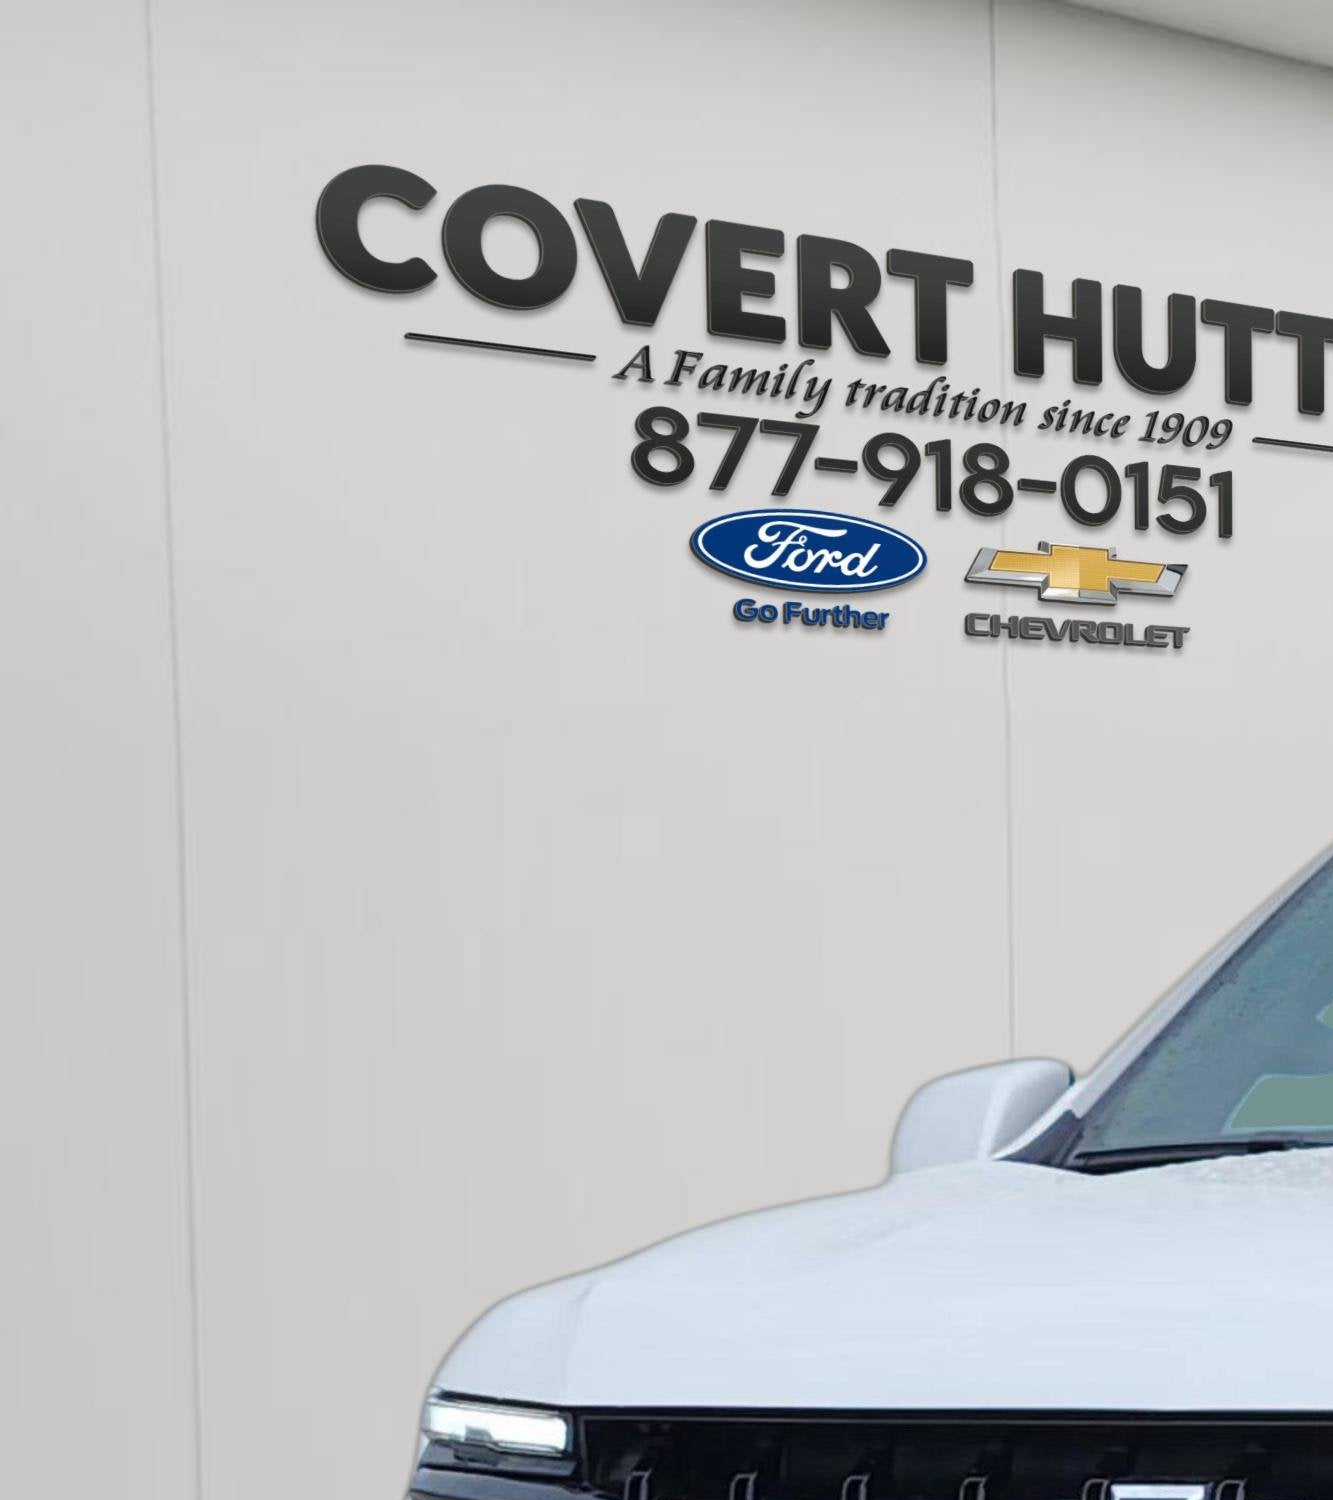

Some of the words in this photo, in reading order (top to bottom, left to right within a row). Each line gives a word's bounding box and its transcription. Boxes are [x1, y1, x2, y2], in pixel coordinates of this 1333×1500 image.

[315, 164, 973, 365] COVERT
[611, 345, 655, 384] A
[664, 349, 832, 418] Family
[844, 367, 1028, 427] tradition
[1037, 399, 1130, 439] since
[1137, 408, 1234, 451] 1909
[630, 406, 1234, 539] 877-918-0151
[743, 521, 880, 579] Ford
[733, 598, 779, 624] Go
[782, 601, 890, 630] Further
[964, 612, 1191, 649] CHEVROLET
